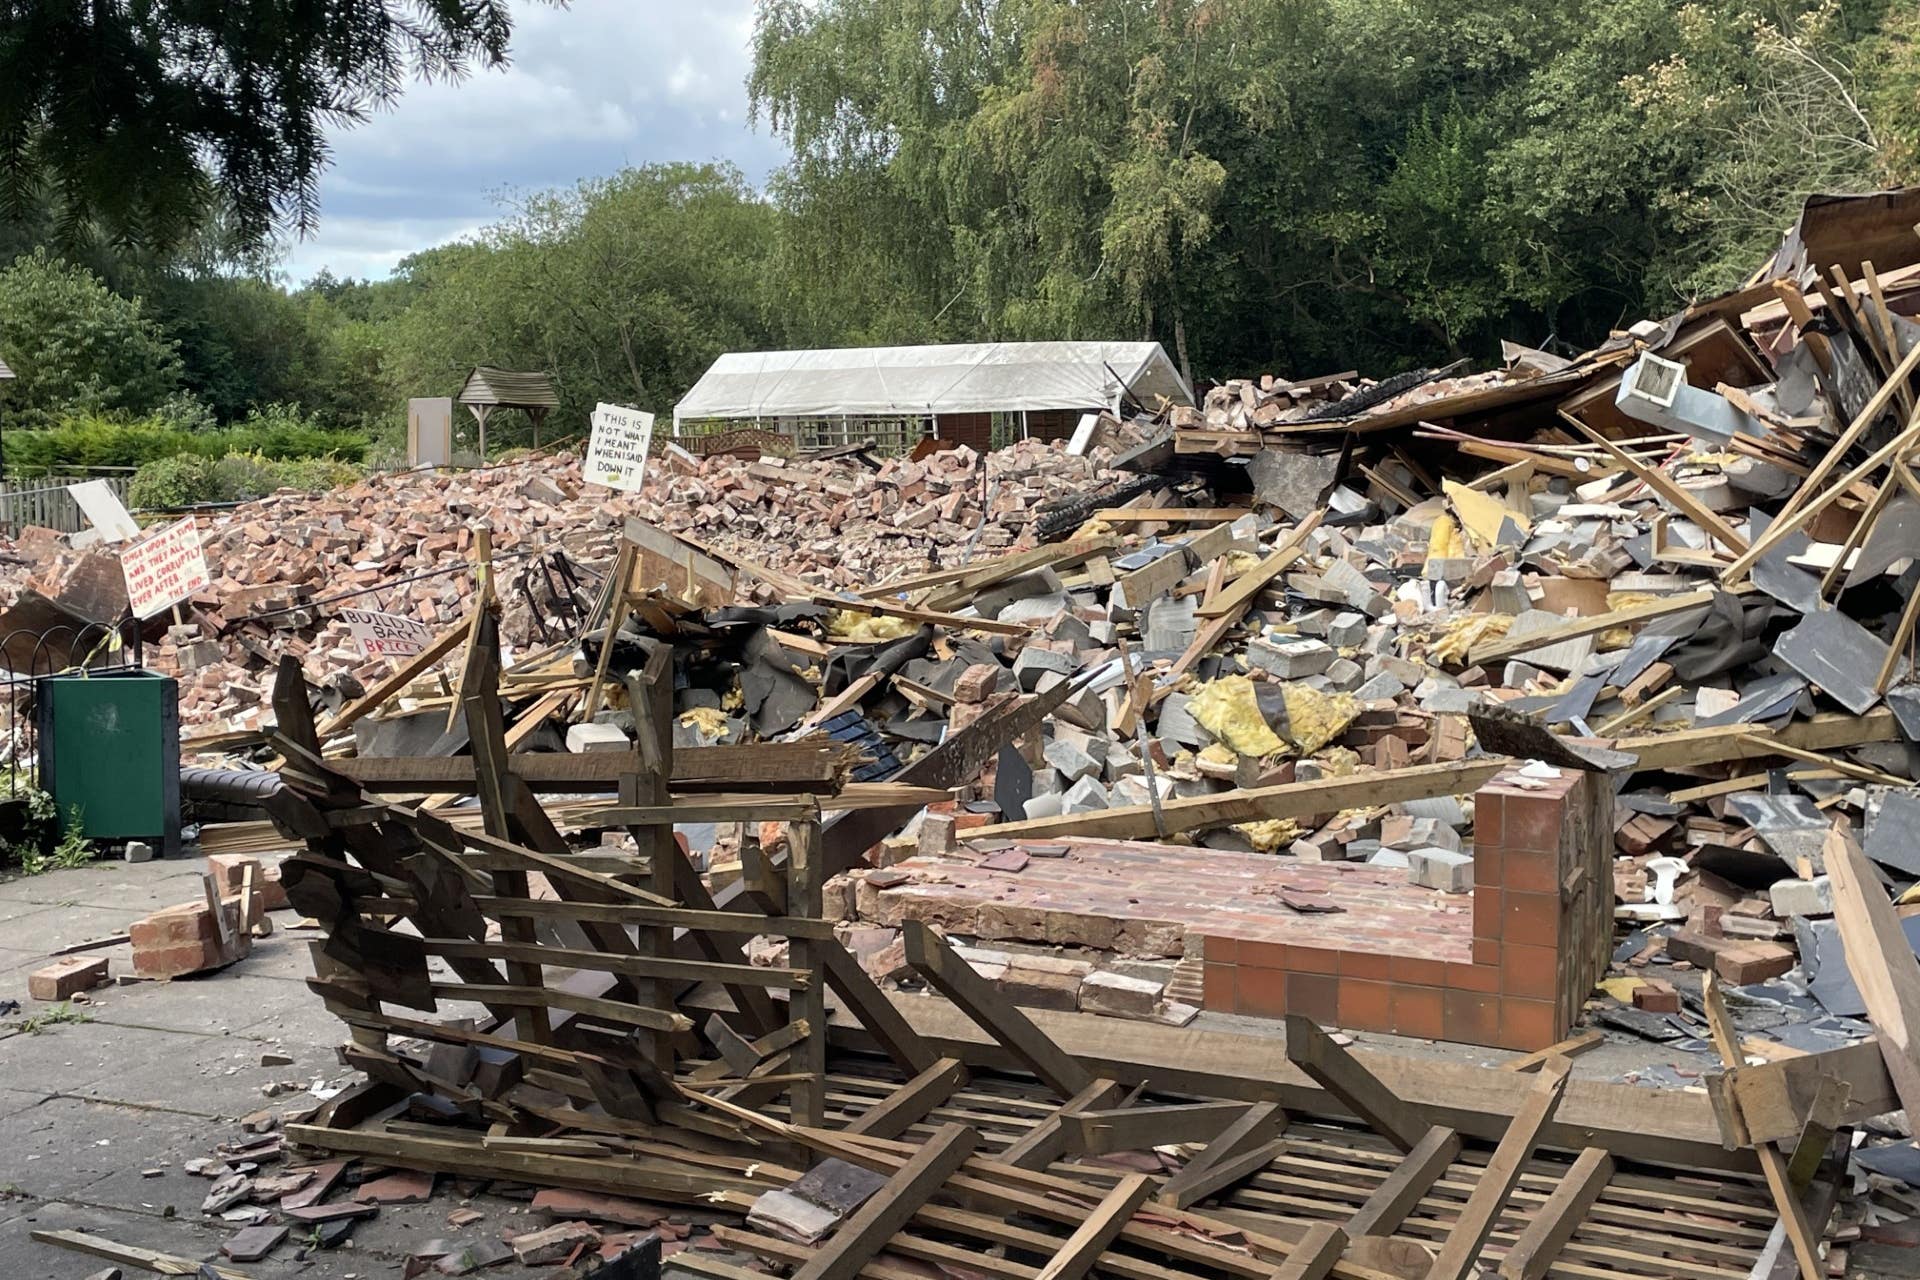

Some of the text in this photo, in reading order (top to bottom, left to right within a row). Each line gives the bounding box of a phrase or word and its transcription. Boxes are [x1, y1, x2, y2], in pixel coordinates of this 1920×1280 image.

[604, 413, 642, 430] THIS IS
[598, 425, 646, 443] NOT WHAT
[604, 438, 637, 451] MEANT
[597, 461, 635, 477] DOWN IT
[122, 521, 195, 565] ONCE UPON A TIME
[128, 545, 185, 579] AND THEY ALL
[129, 545, 200, 594] LIVED CORRUPTLY
[168, 576, 202, 600] THE END
[131, 589, 152, 608] EVER
[346, 610, 428, 637] BUILD IT
[372, 626, 417, 641] BACK
